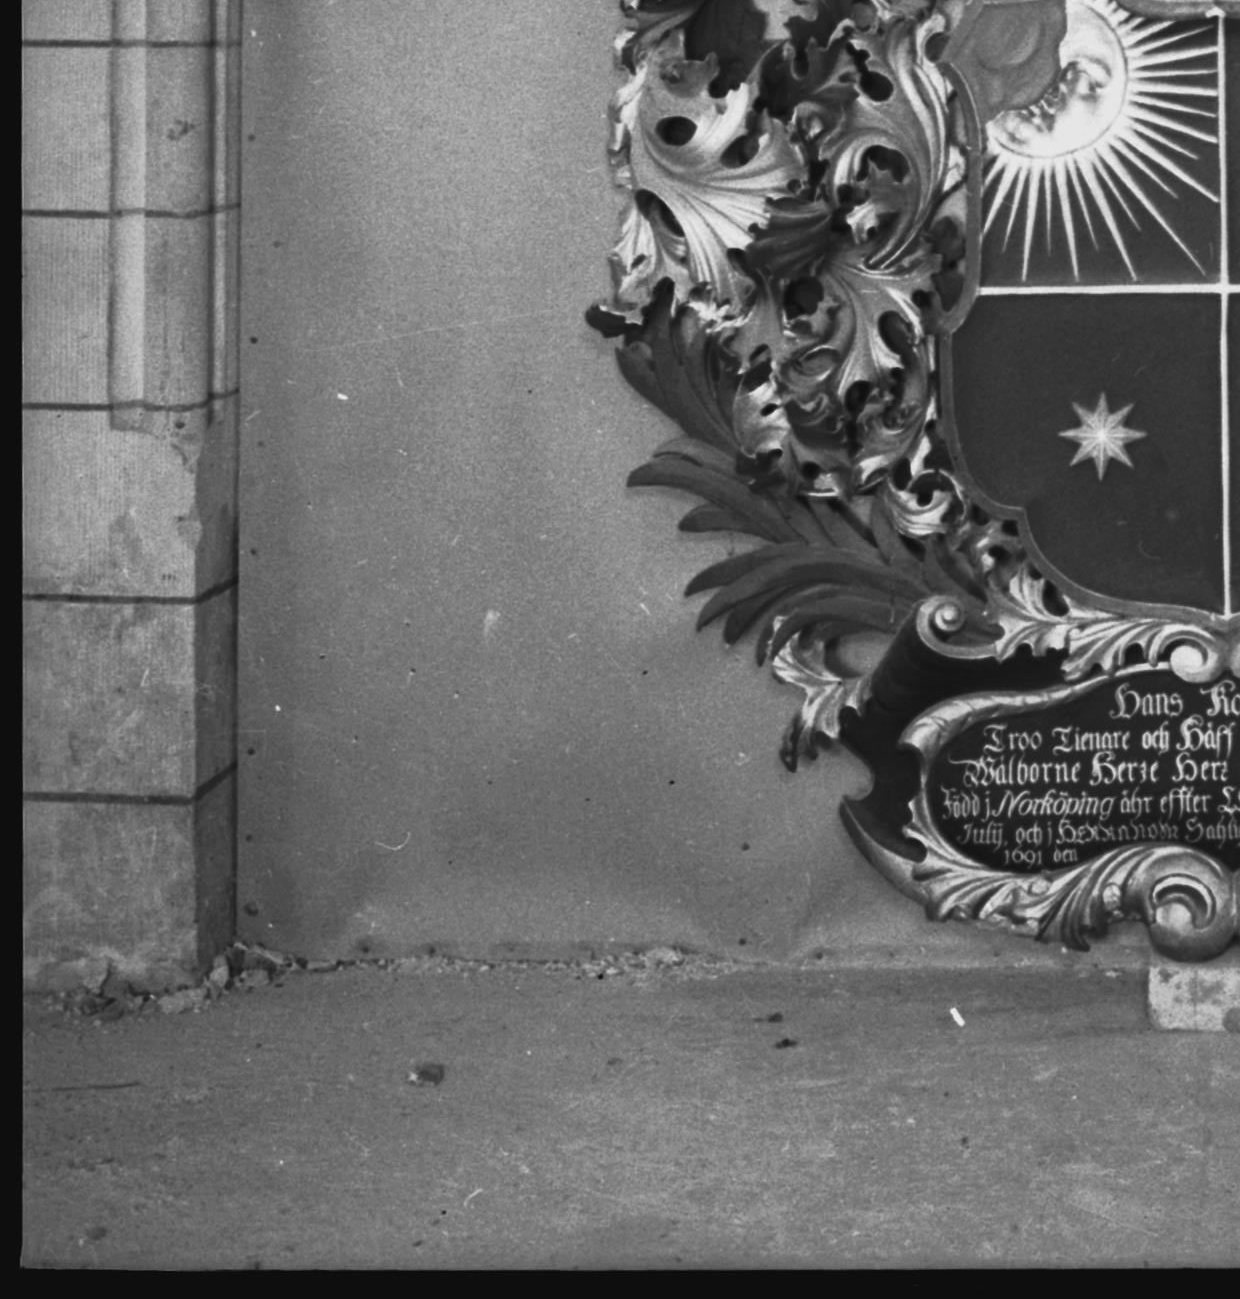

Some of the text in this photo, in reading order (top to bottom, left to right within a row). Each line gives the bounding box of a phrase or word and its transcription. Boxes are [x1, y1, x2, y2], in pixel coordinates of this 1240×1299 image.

[1110, 683, 1183, 719] Hans
[983, 723, 1042, 753] Troo
[1052, 725, 1130, 756] Tienare
[1141, 720, 1169, 755] och
[992, 789, 1116, 821] Norköping
[1120, 786, 1153, 820] åhr
[1016, 821, 1043, 849] och
[1004, 849, 1042, 868] 1691
[1053, 848, 1078, 862] den
